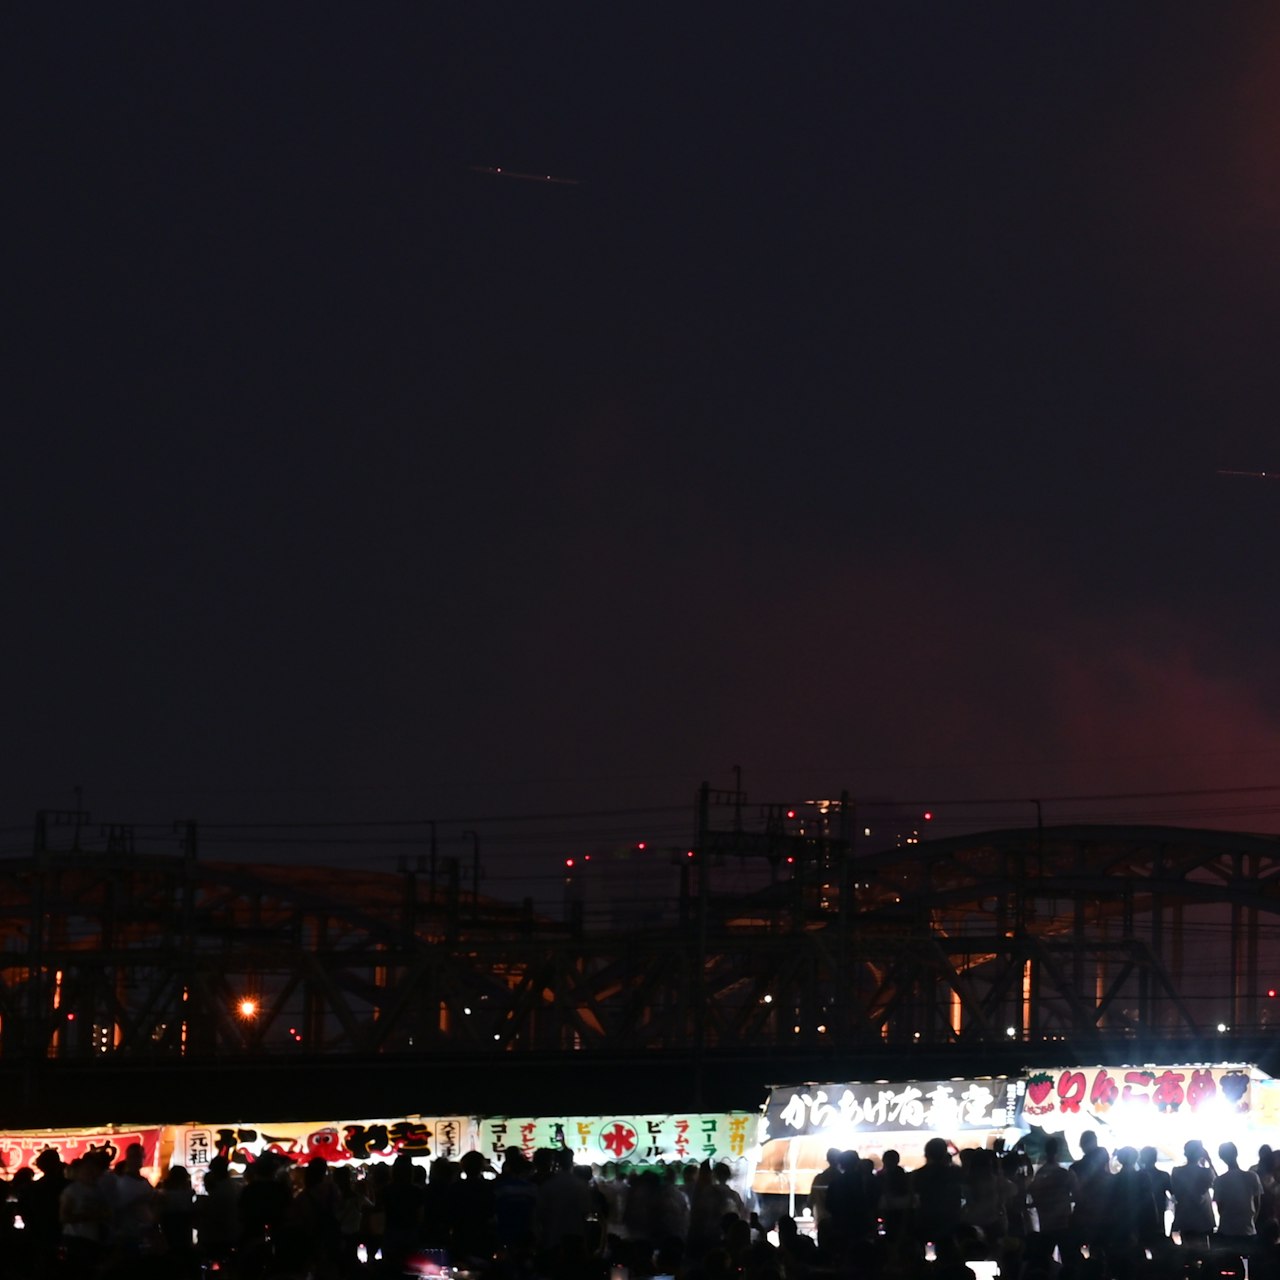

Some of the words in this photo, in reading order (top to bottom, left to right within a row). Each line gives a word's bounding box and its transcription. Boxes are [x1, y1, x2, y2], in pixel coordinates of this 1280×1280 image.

[1057, 1070, 1217, 1113] りんごあめ
[189, 1133, 209, 1166] 元祖
[490, 1123, 508, 1161] コーヒー
[577, 1122, 594, 1153] ビー
[646, 1120, 666, 1158] ビール
[674, 1119, 690, 1158] ラムネ
[701, 1120, 718, 1157] コーラ
[729, 1117, 749, 1156] ポカリ
